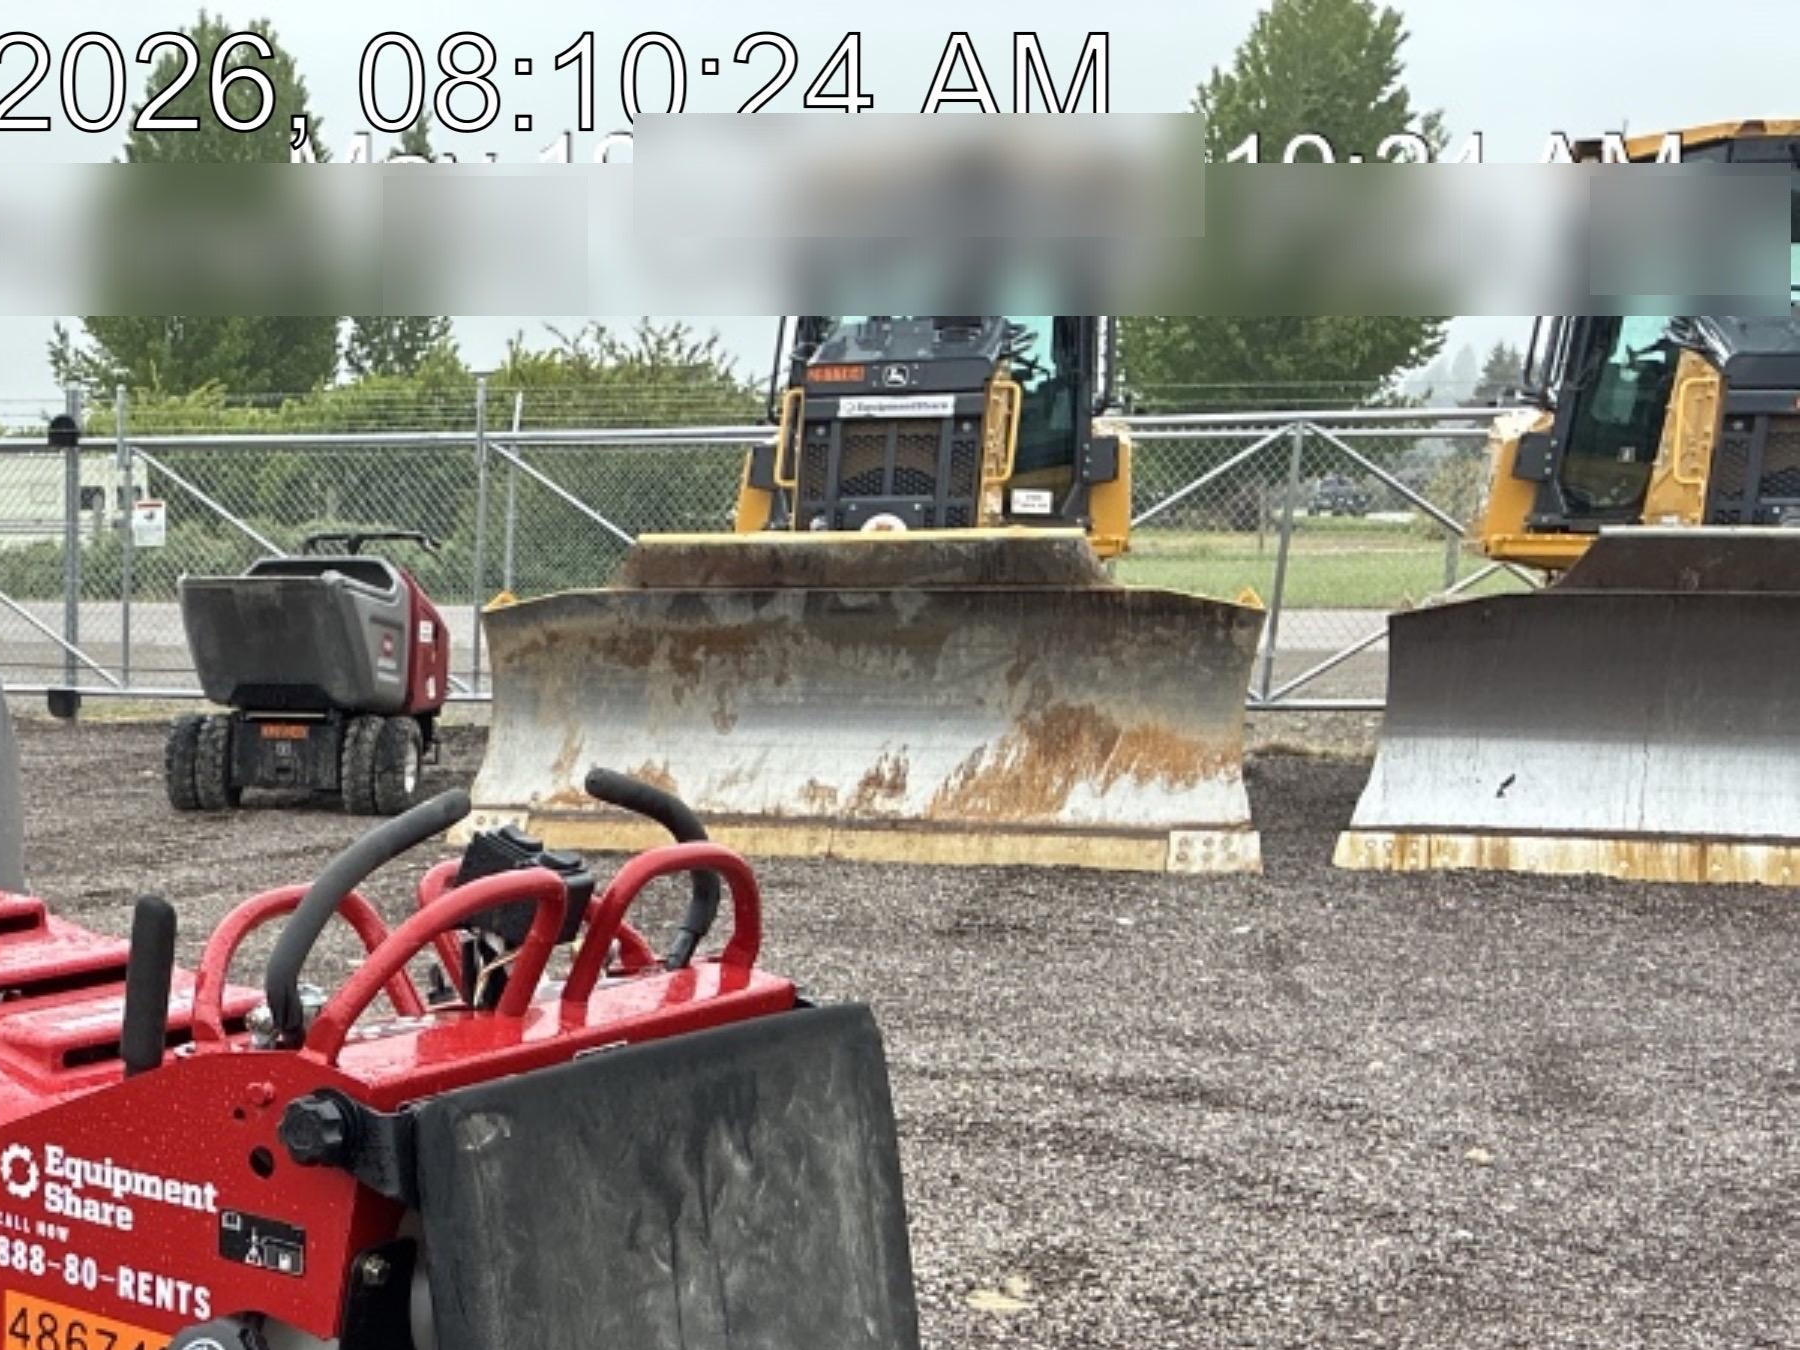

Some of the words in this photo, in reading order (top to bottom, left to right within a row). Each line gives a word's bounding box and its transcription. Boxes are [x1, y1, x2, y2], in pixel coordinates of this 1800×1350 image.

[44, 1143, 218, 1214] Equipment
[35, 1220, 70, 1243] NOW
[44, 1181, 134, 1232] Share
